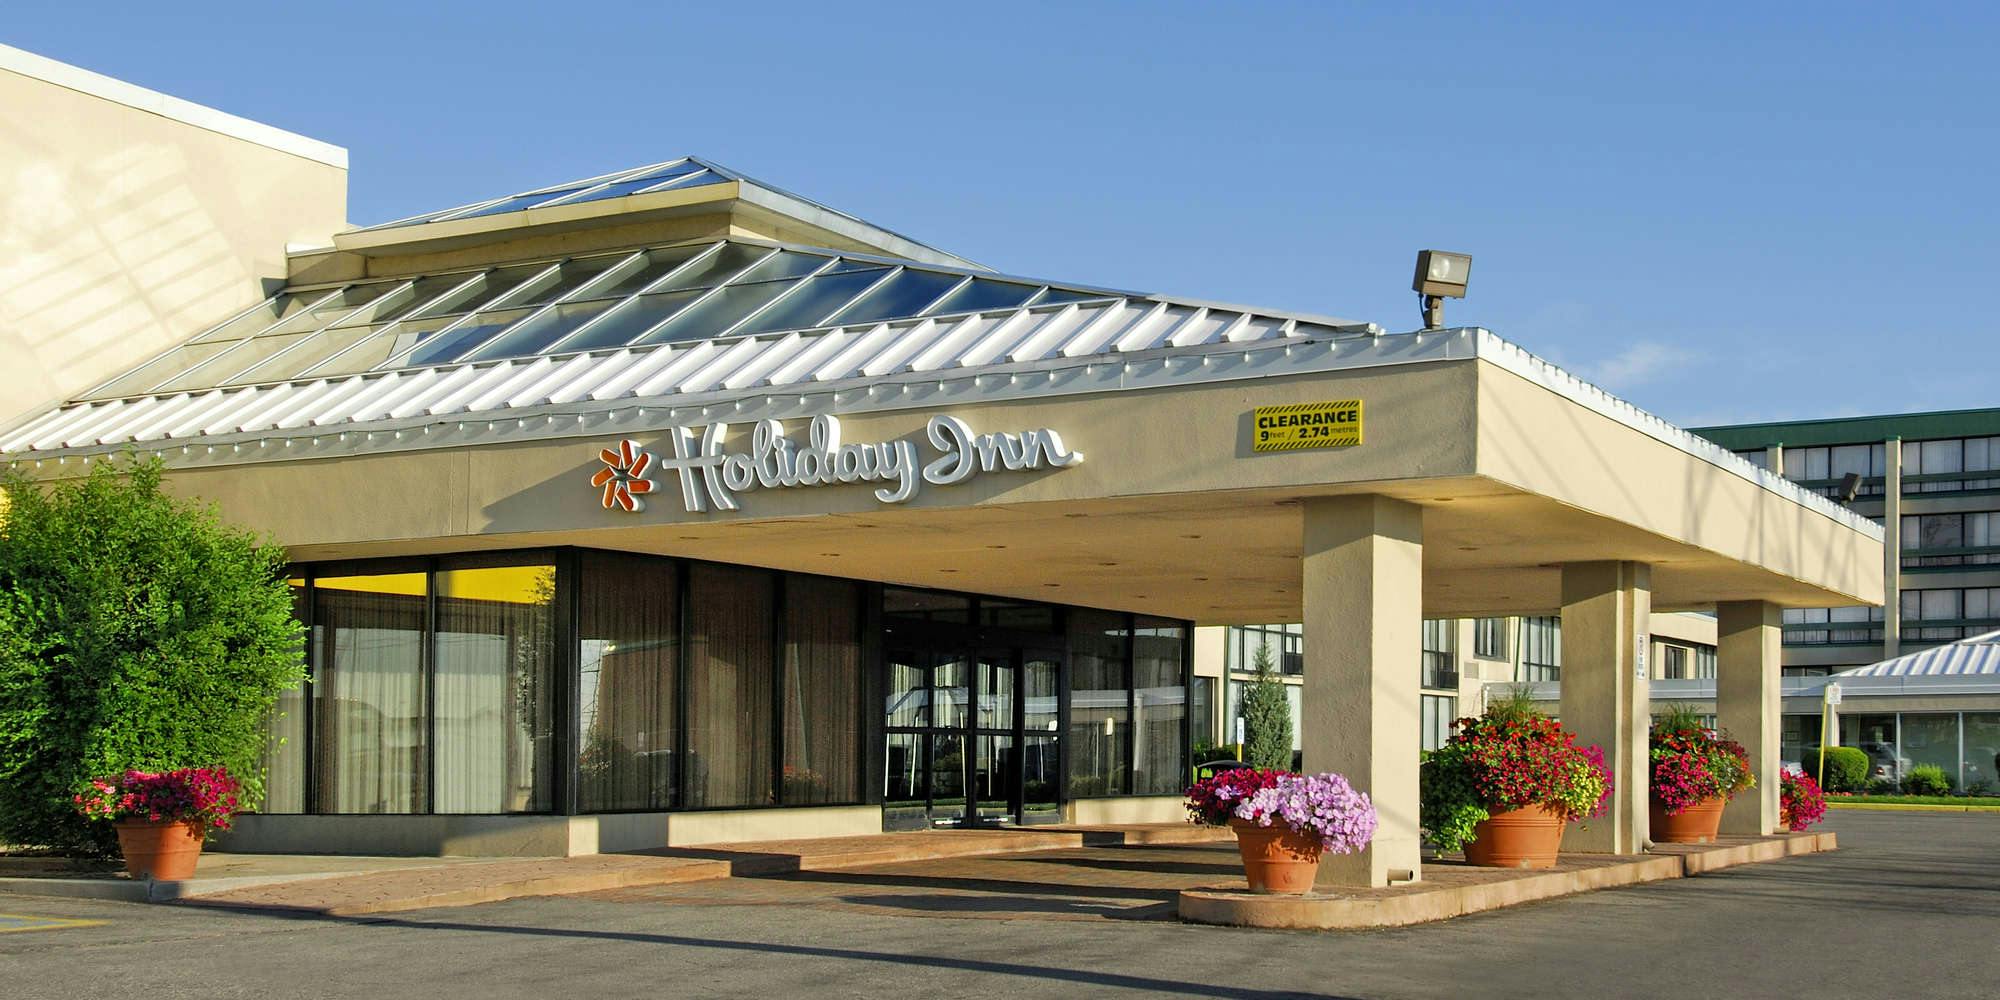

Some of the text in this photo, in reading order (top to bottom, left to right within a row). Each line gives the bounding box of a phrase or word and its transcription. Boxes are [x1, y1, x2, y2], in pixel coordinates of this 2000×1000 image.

[1258, 410, 1357, 429] CLEARANCE
[1260, 431, 1269, 441] 9
[1298, 426, 1329, 438] 2.74
[663, 413, 1084, 512] Holiday Inn
